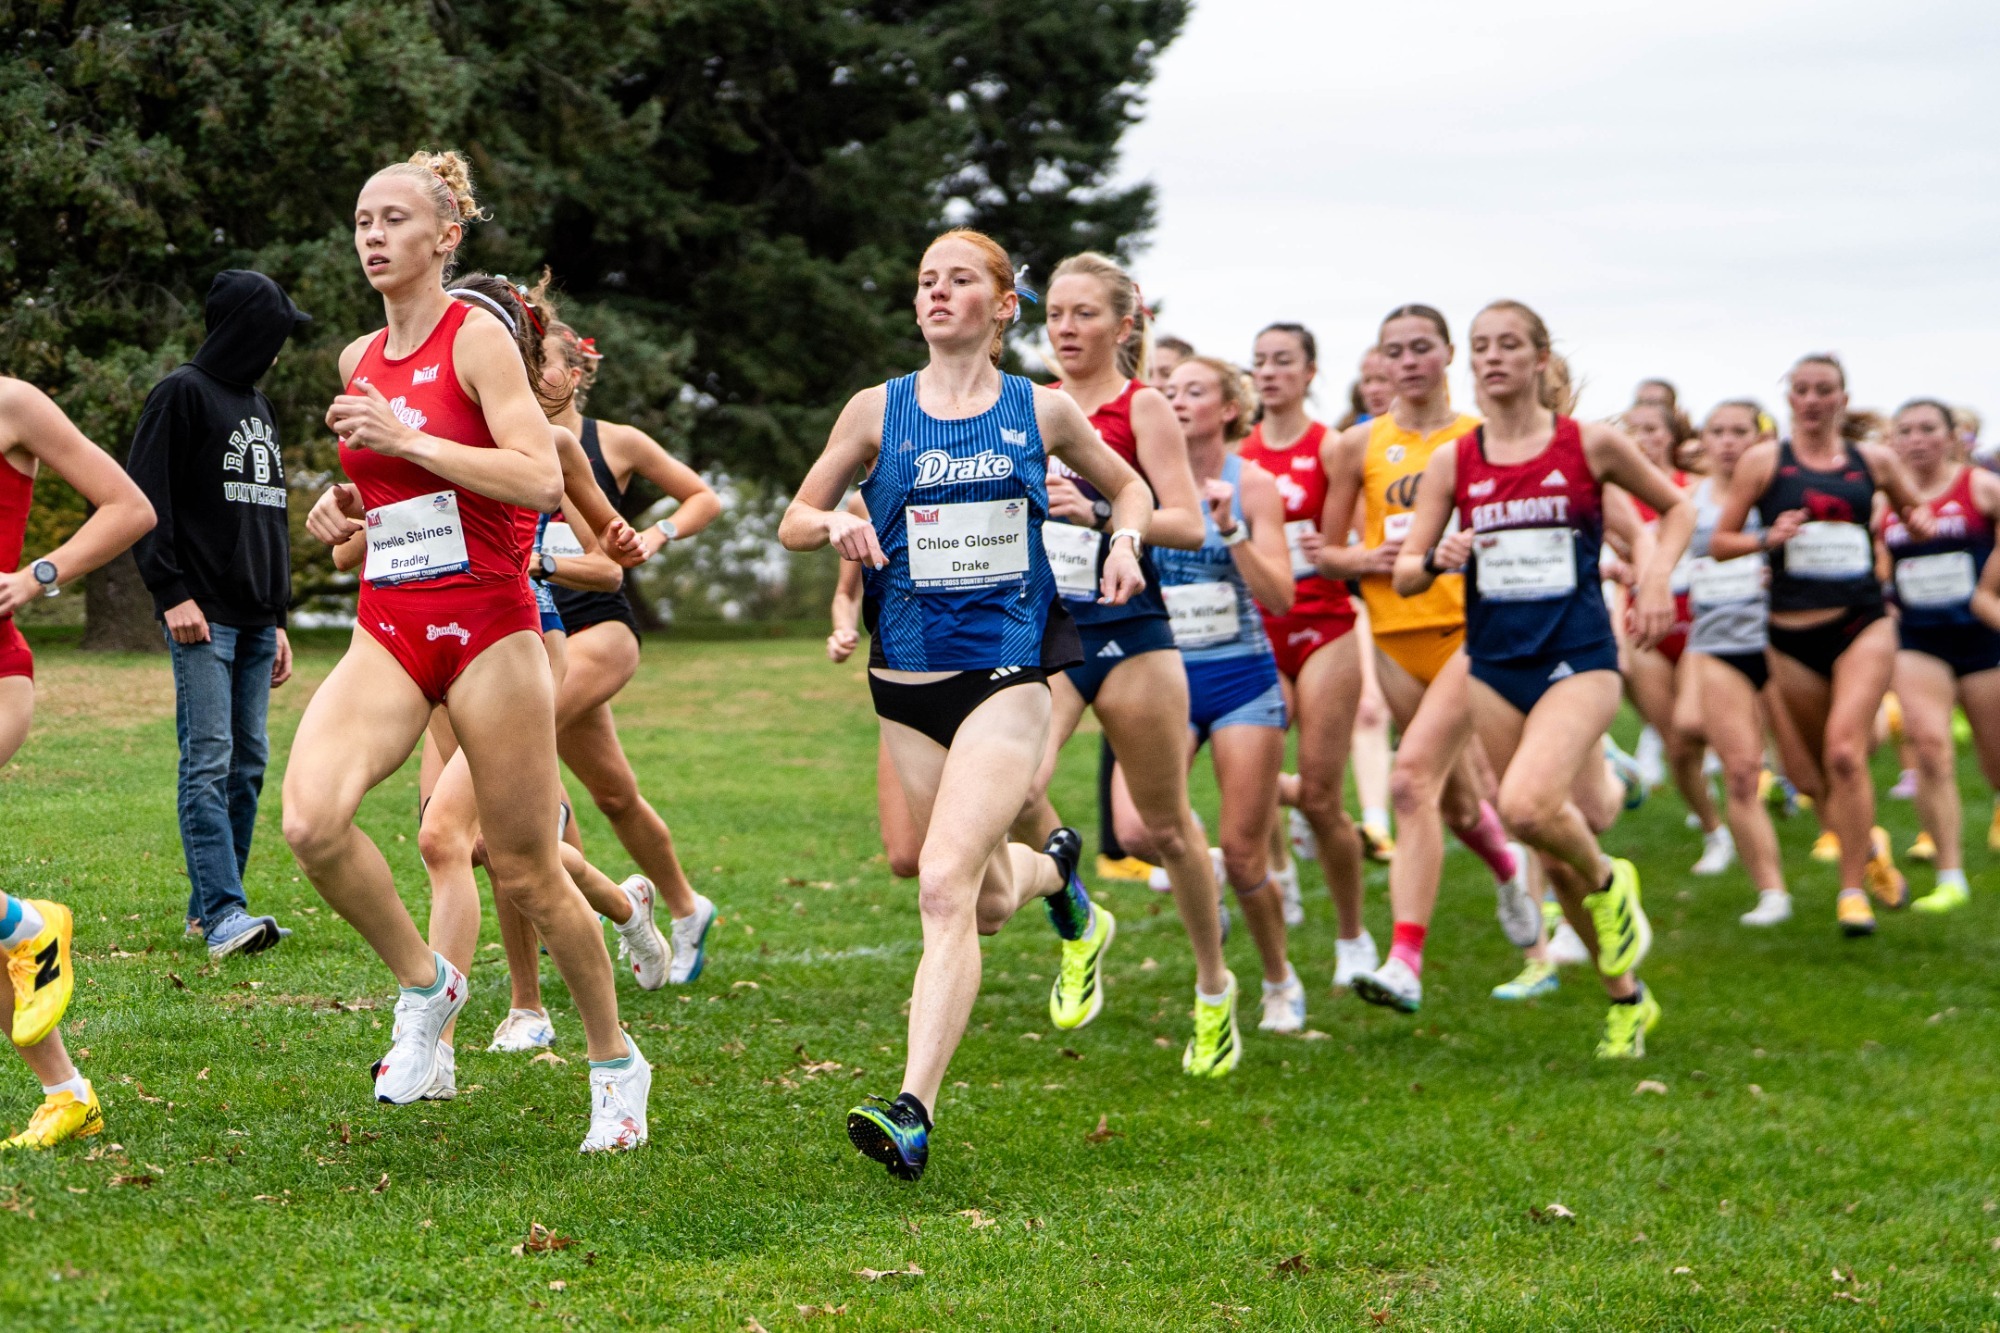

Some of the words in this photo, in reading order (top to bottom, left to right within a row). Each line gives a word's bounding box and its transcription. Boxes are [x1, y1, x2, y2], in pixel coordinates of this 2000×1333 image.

[251, 444, 270, 483] B
[914, 449, 1014, 489] Drake
[223, 482, 287, 508] UNIVERSIT
[1471, 495, 1570, 532] BELMONT
[373, 536, 405, 552] Noelle
[406, 525, 453, 544] Steines
[917, 537, 960, 550] Chloe
[964, 533, 1019, 548] Glosser
[391, 554, 430, 569] Bradley
[952, 560, 990, 572] Drake
[1058, 553, 1088, 566] Harte
[943, 578, 959, 586] CROSS
[960, 576, 984, 585] COUNTRY
[984, 572, 1023, 583] CHAMPIONSHIPS
[426, 621, 471, 646] Bradley
[35, 937, 61, 992] N
